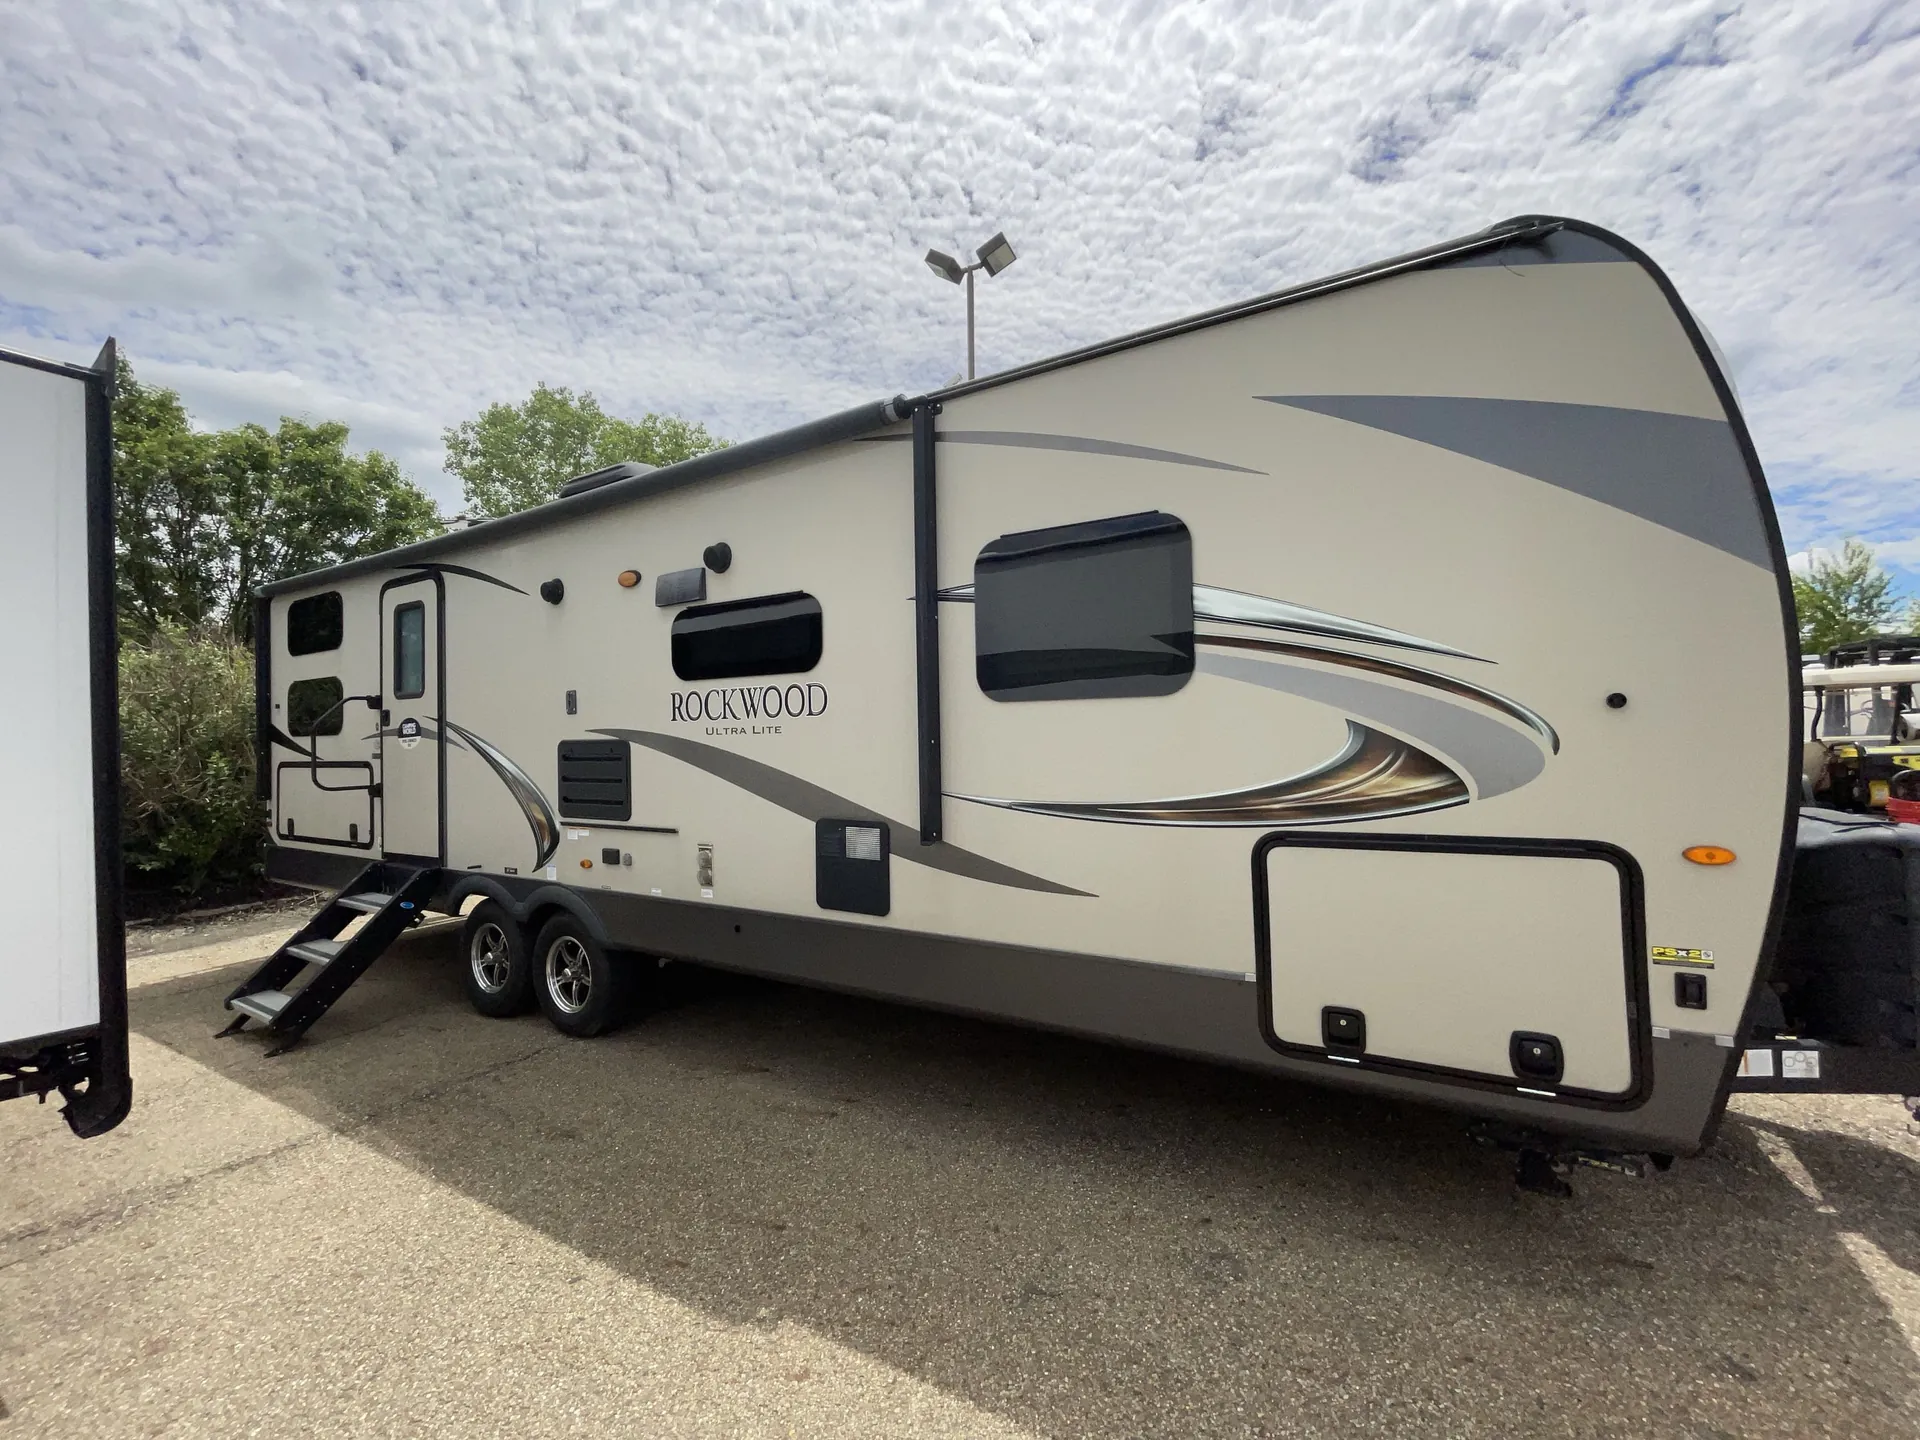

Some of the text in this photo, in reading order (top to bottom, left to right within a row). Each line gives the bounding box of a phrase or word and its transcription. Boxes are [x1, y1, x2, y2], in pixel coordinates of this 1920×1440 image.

[670, 682, 828, 722] ROCKWOOD
[705, 725, 782, 736] ULTRA LITE
